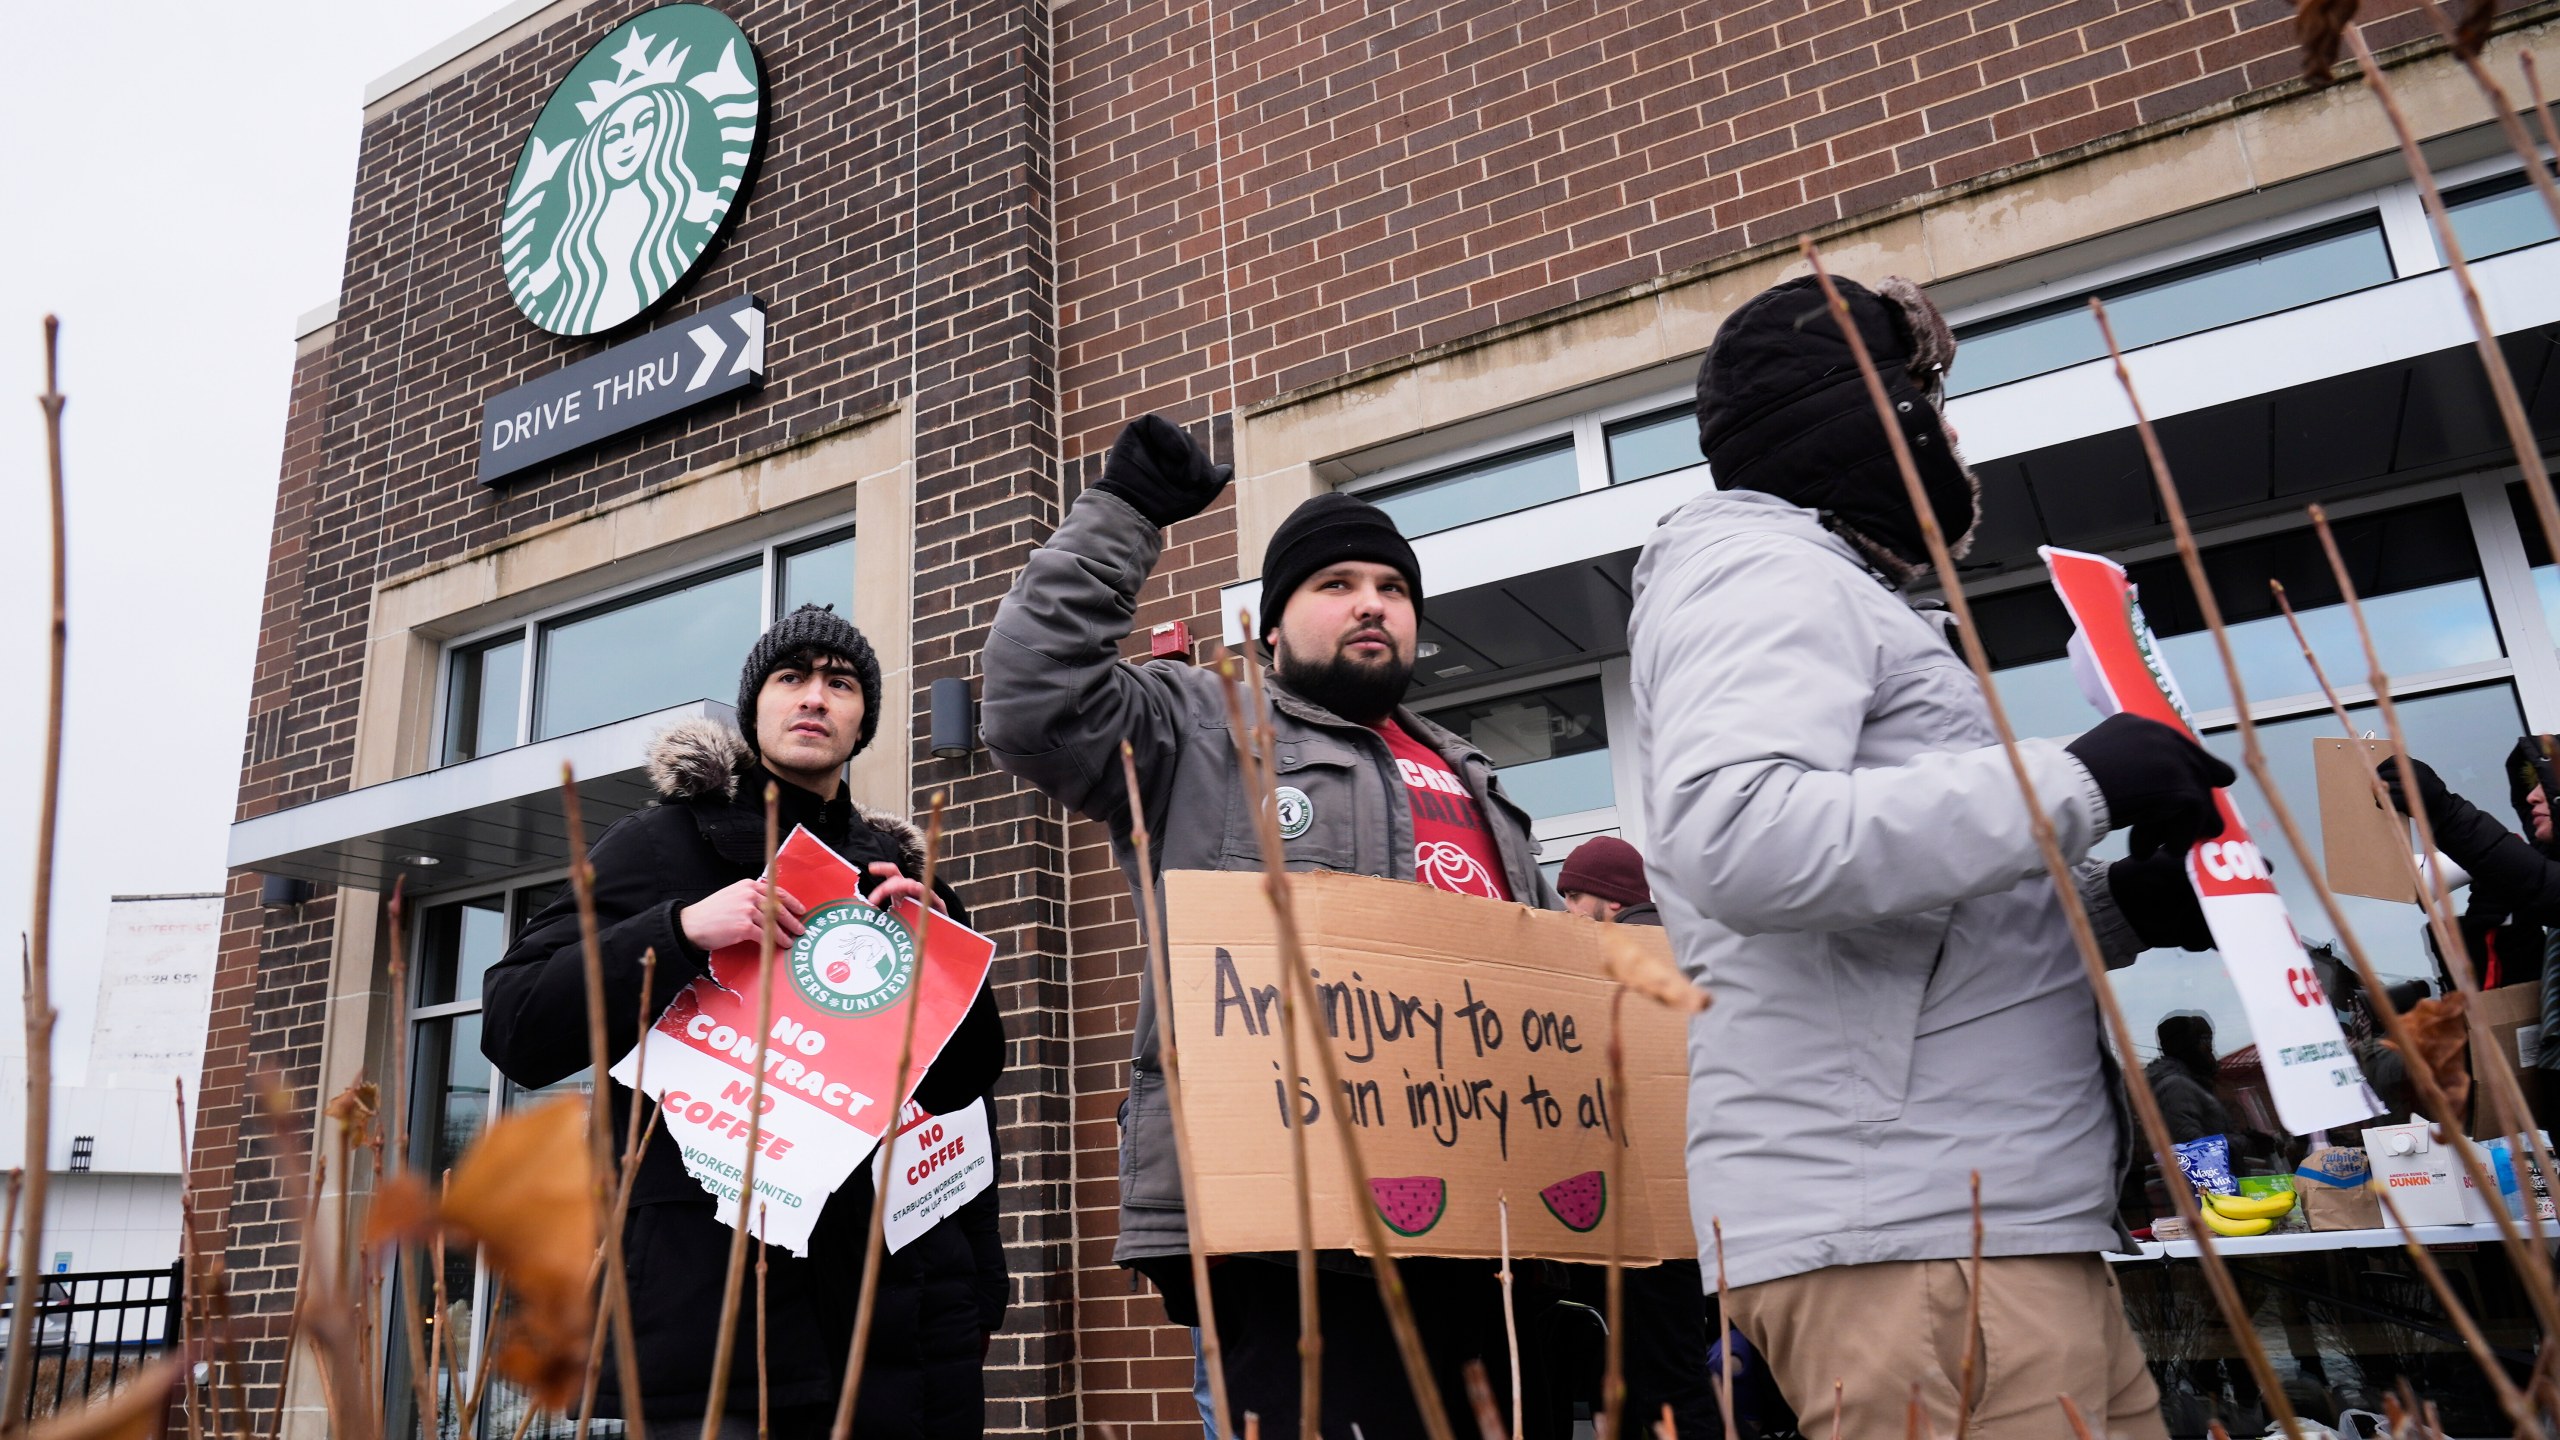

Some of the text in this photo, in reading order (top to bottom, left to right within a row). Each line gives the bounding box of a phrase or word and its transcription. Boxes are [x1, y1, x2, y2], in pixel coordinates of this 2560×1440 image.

[492, 351, 679, 452] DRIVE THRU
[826, 908, 914, 963] STARBUCKS
[795, 925, 831, 1003] WORKERS
[842, 973, 907, 1011] UNITED
[1214, 946, 1582, 1070] An injury to one
[770, 1015, 826, 1056] NO
[686, 1014, 875, 1117] CONTRACT
[720, 1079, 775, 1116] NO
[1272, 1060, 1321, 1129] is
[1403, 1067, 1508, 1162] injury
[1520, 1074, 1562, 1130] to
[1578, 1077, 1628, 1148] al
[661, 1090, 795, 1161] COFFEE
[918, 1123, 944, 1151] NO
[907, 1135, 965, 1186] COFFEE
[2191, 1167, 2220, 1179] Magic
[2322, 1162, 2362, 1173] Castle
[2326, 1151, 2360, 1163] White
[752, 1177, 803, 1209] UNITED
[892, 1156, 985, 1222] STARBUCKS WORKERS UNITED
[920, 1205, 931, 1218] ON
[943, 1181, 967, 1202] STRIKE!
[2191, 1176, 2232, 1188] Trail Mix
[2389, 1176, 2431, 1187] DUNKIN
